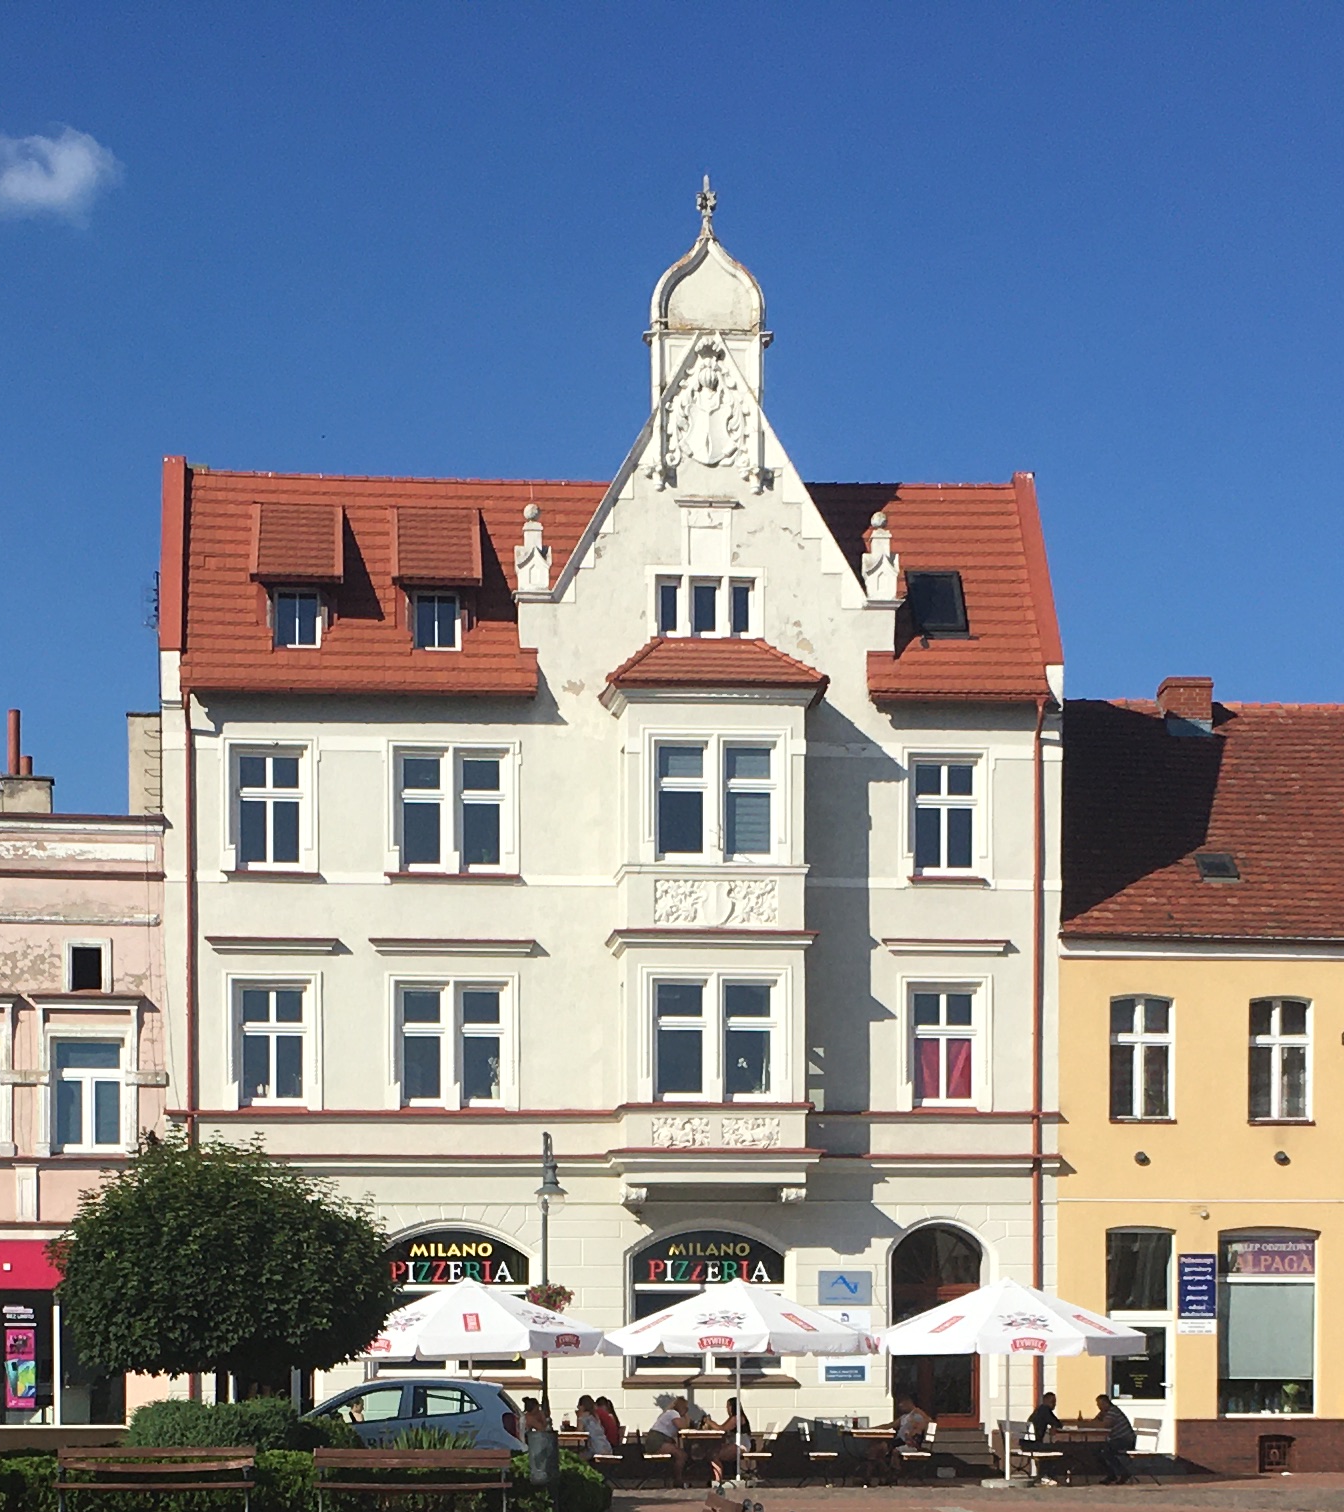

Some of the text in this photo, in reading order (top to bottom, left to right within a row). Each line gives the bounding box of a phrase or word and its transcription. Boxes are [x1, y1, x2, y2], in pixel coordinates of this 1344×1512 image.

[410, 1242, 493, 1257] MILANO
[668, 1242, 750, 1256] MILANO
[389, 1261, 514, 1283] PIZZERIA
[648, 1260, 771, 1282] PIZZERIA
[1232, 1253, 1312, 1272] ALPAGA
